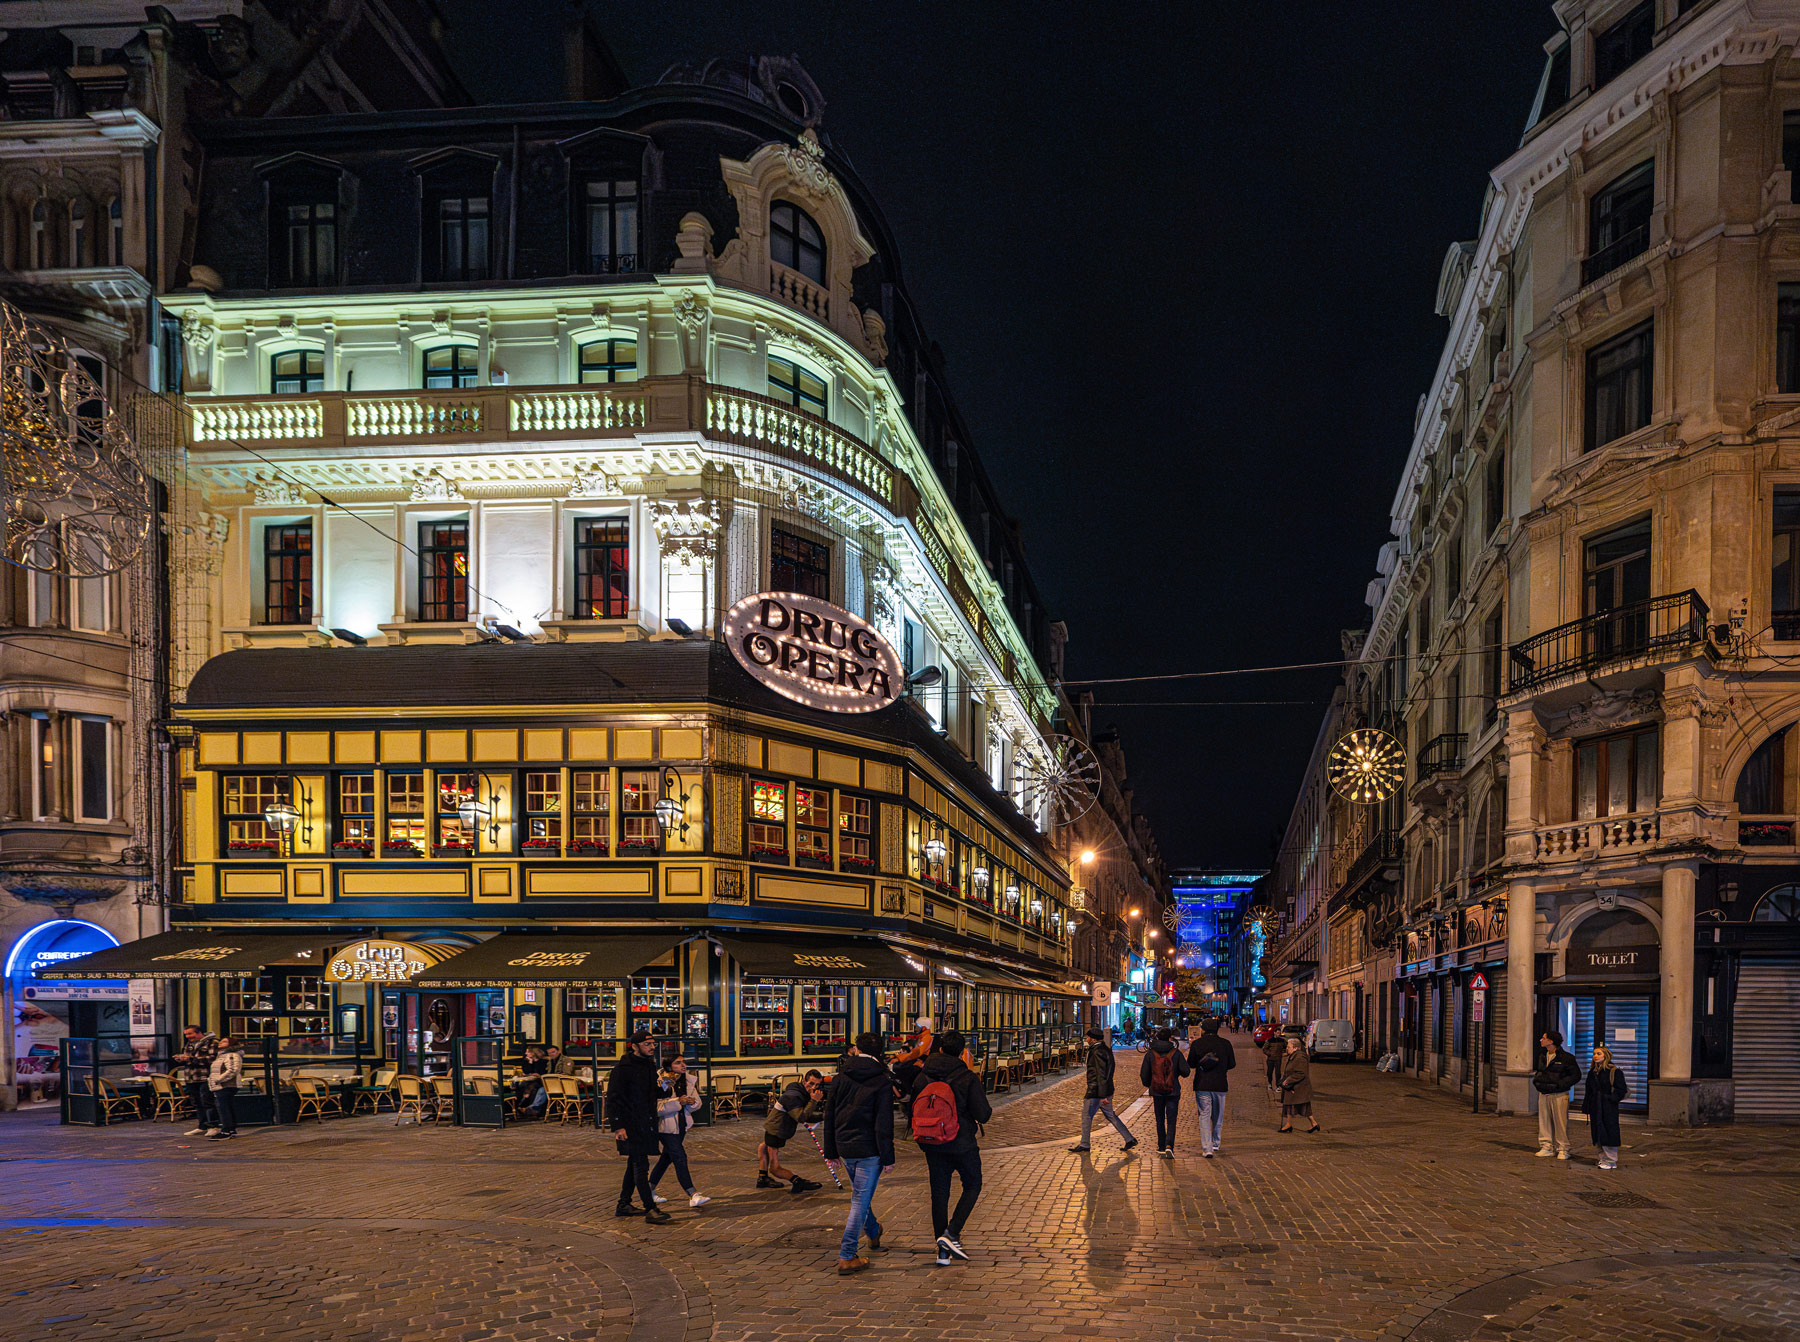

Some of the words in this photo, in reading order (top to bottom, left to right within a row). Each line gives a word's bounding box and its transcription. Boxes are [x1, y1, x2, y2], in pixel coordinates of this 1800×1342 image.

[759, 598, 880, 660] DRUG
[742, 632, 895, 700] OPERA
[1600, 896, 1613, 905] 34
[356, 942, 403, 962] drug
[525, 952, 591, 960] DRUG
[507, 958, 585, 967] OPERA
[793, 953, 852, 963] DRUG
[1587, 952, 1639, 965] TOLLET
[793, 959, 867, 969] OPERA
[331, 959, 426, 980] OPERA
[466, 980, 481, 988] SALAD
[486, 980, 512, 988] TEA-ROOM
[517, 980, 567, 988] TAVERN-RESTAURANT
[572, 980, 588, 988] PIZZA
[592, 980, 603, 988] PUB
[608, 980, 622, 988] GRILL
[760, 977, 775, 985] PASTA
